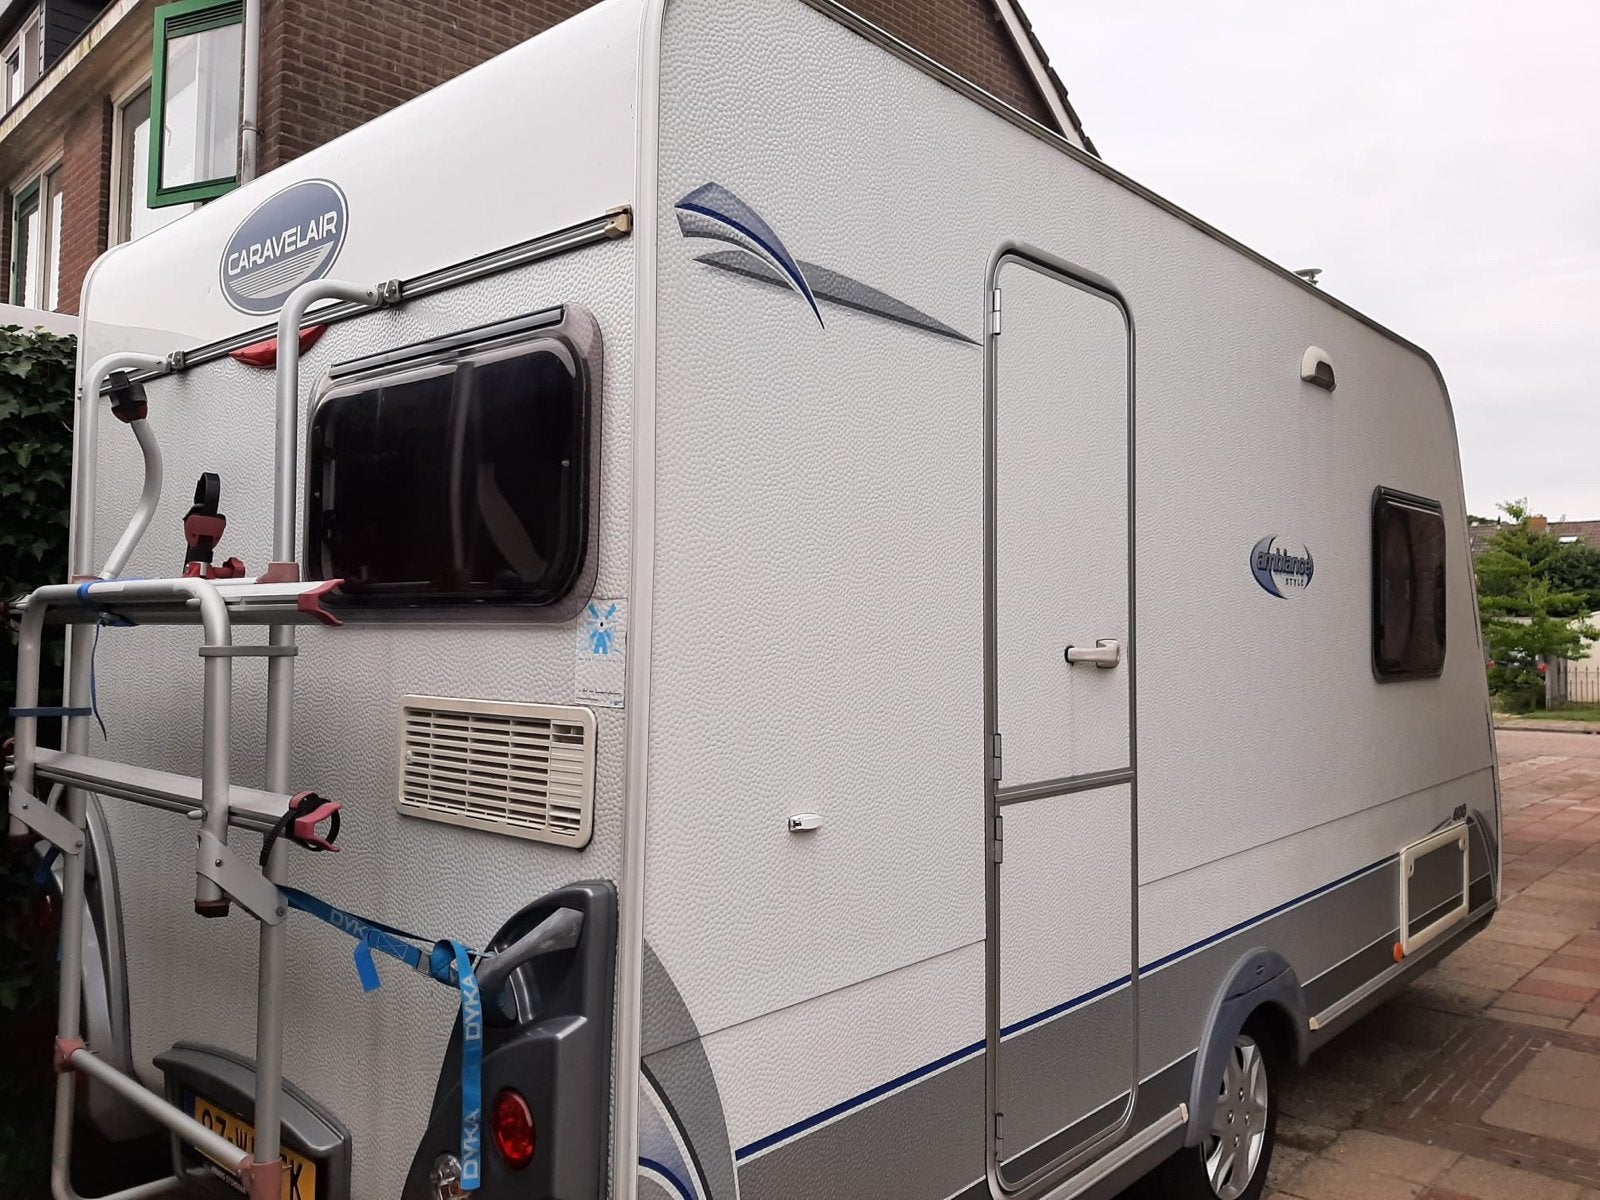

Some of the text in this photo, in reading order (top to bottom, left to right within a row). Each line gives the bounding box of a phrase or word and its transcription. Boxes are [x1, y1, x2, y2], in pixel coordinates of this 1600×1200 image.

[228, 211, 338, 276] CARAVELAIR
[1256, 547, 1313, 576] ambiance
[463, 975, 482, 1042] DYKA
[463, 1107, 481, 1180] DYKA
